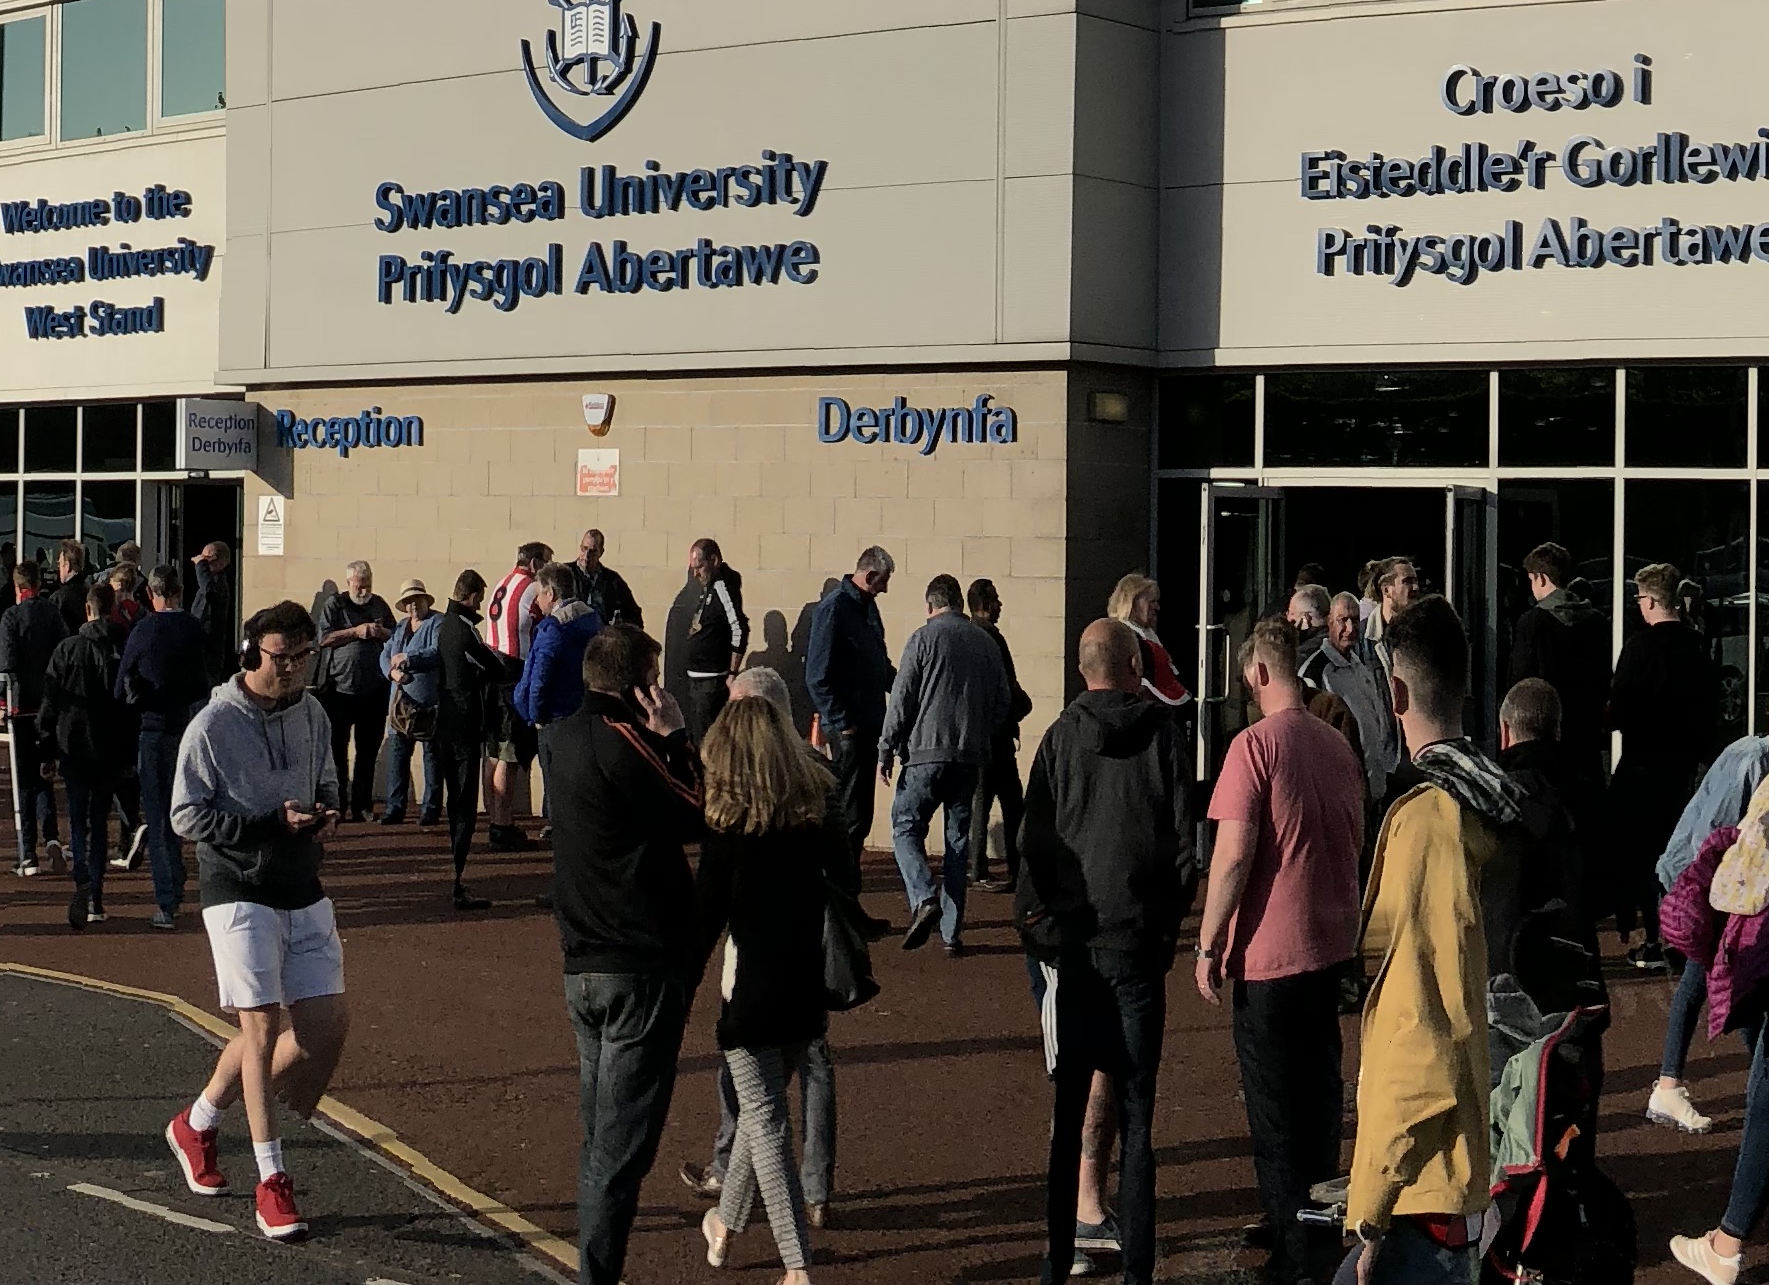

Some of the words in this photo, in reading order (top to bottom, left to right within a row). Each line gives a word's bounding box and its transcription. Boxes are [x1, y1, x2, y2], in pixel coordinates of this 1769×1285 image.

[1439, 63, 1624, 116] Croeso
[1633, 52, 1653, 105] i
[374, 182, 565, 233] Swansea
[579, 149, 829, 217] University
[1300, 139, 1557, 201] Eisteddle'r
[0, 198, 111, 235] Welcome
[112, 191, 142, 223] to
[143, 184, 193, 220] the
[87, 237, 216, 282] University
[378, 243, 563, 315] Prifysgol
[573, 238, 820, 295] Abertawe
[1316, 219, 1524, 288] Prifysgol
[24, 305, 88, 340] West
[88, 296, 165, 336] Stand
[188, 412, 255, 433] Reception
[276, 406, 424, 458] Reception
[818, 393, 1018, 456] Derbynfa
[489, 585, 507, 621] 8
